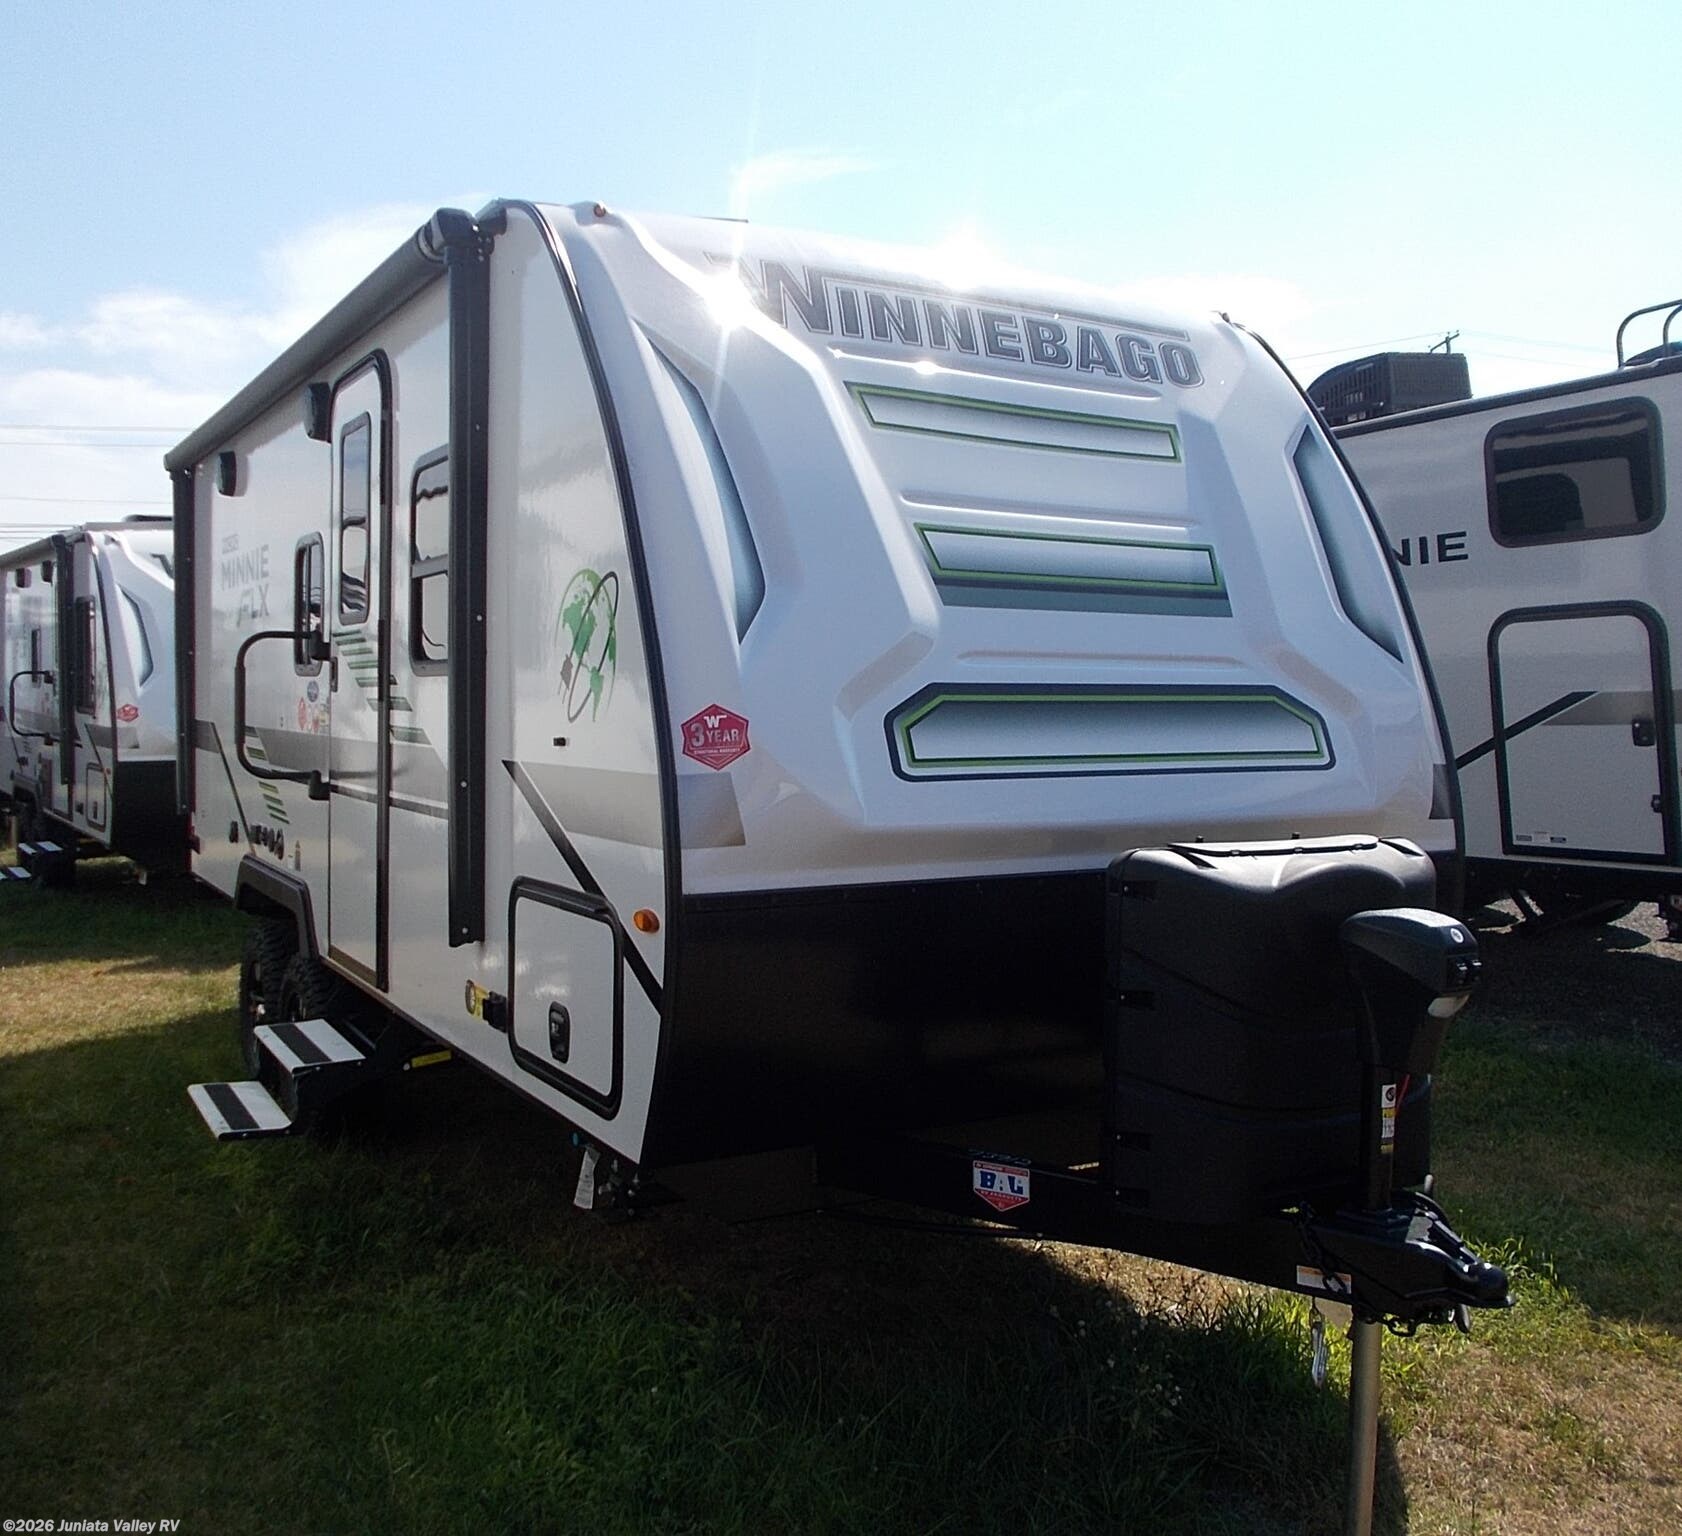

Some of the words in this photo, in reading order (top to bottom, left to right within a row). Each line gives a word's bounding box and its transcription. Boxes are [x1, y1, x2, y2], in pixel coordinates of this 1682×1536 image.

[703, 251, 1205, 388] WINNEBAGO
[221, 543, 270, 591] MINNIE
[690, 722, 705, 747] 3
[706, 728, 740, 743] YEAR
